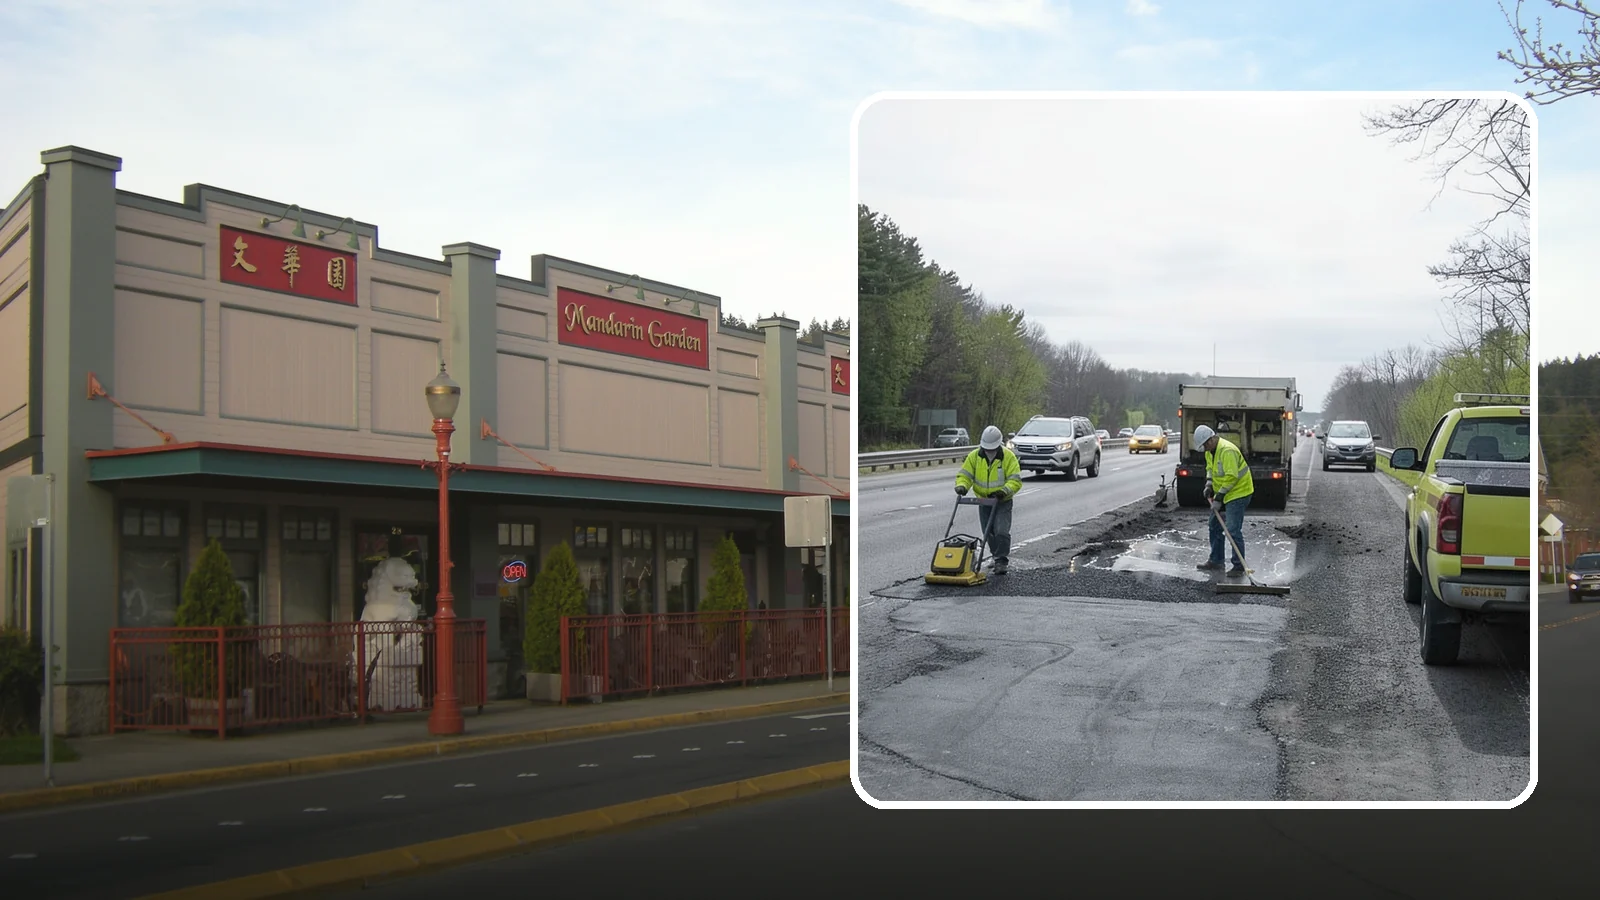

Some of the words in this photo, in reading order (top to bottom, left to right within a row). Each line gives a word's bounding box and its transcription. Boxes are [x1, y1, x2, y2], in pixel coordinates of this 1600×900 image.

[230, 235, 347, 291] 文華園
[564, 302, 644, 341] Mandarin
[648, 320, 701, 352] Garden
[834, 363, 847, 387] 文
[503, 565, 527, 578] OPEN
